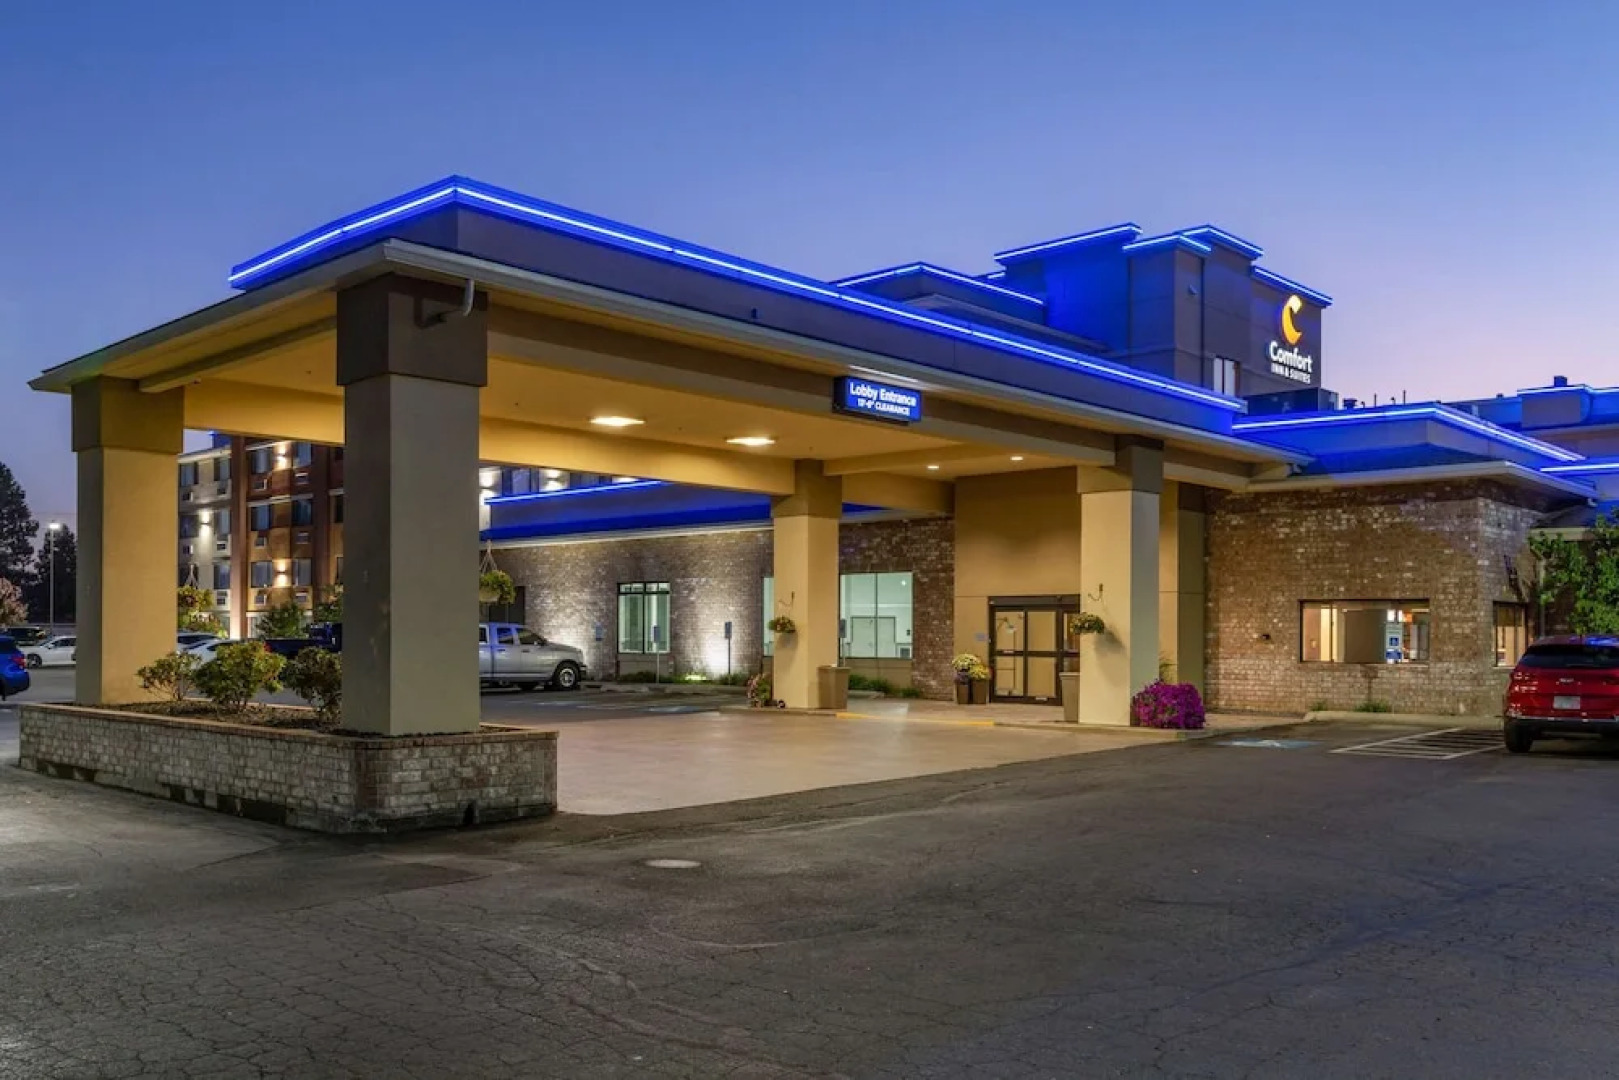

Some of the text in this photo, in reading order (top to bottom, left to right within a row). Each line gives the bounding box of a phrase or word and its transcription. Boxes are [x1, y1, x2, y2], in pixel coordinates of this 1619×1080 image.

[1270, 340, 1312, 373] Comfort
[1271, 362, 1285, 375] INN
[1289, 368, 1311, 385] SUITES
[849, 382, 917, 407] Lobby Entrance
[875, 401, 911, 416] CLEARANCE
